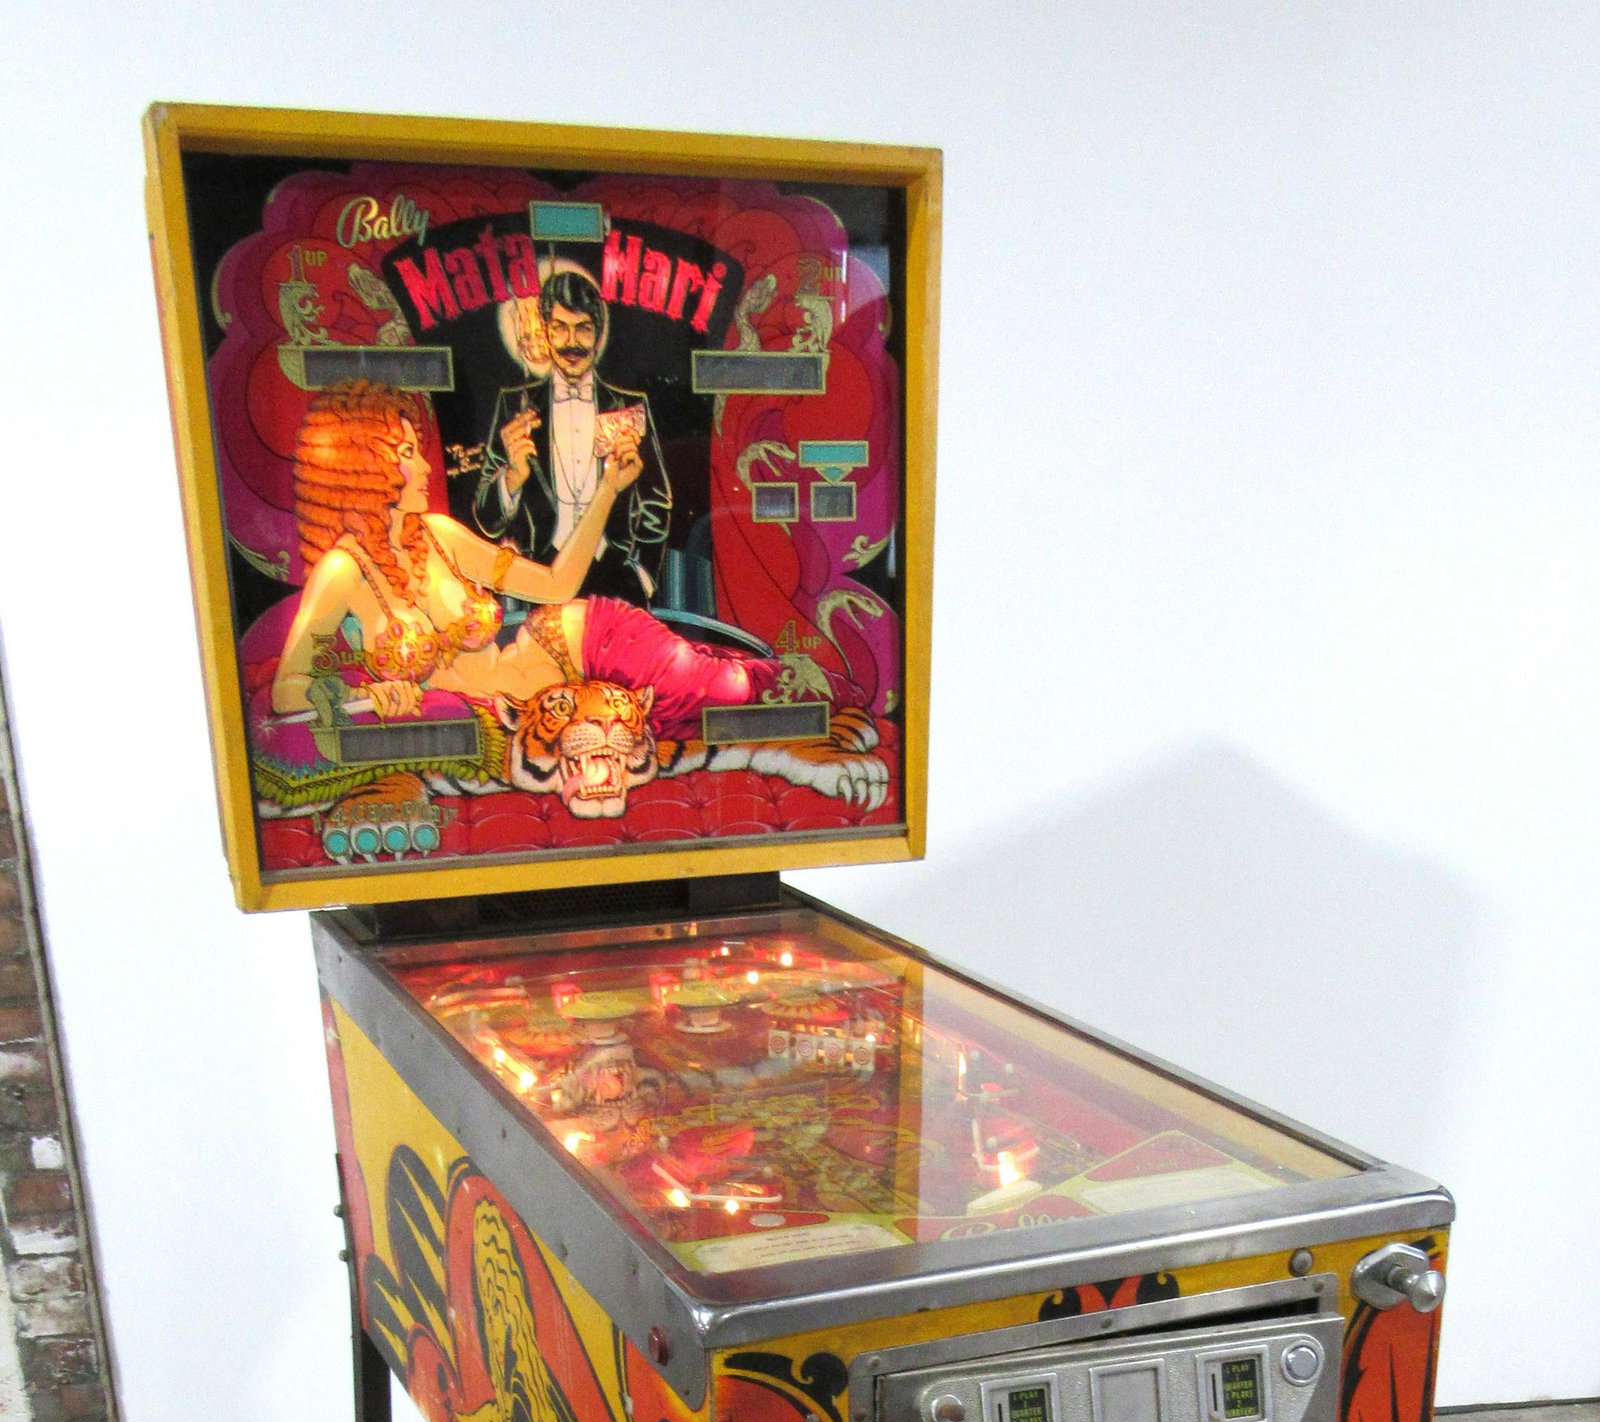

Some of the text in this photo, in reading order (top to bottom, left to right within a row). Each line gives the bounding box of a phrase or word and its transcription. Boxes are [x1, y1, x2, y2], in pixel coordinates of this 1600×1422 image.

[336, 194, 430, 249] Bally
[393, 222, 727, 334] Mata Hari
[310, 632, 340, 672] 3
[775, 619, 800, 654] 4
